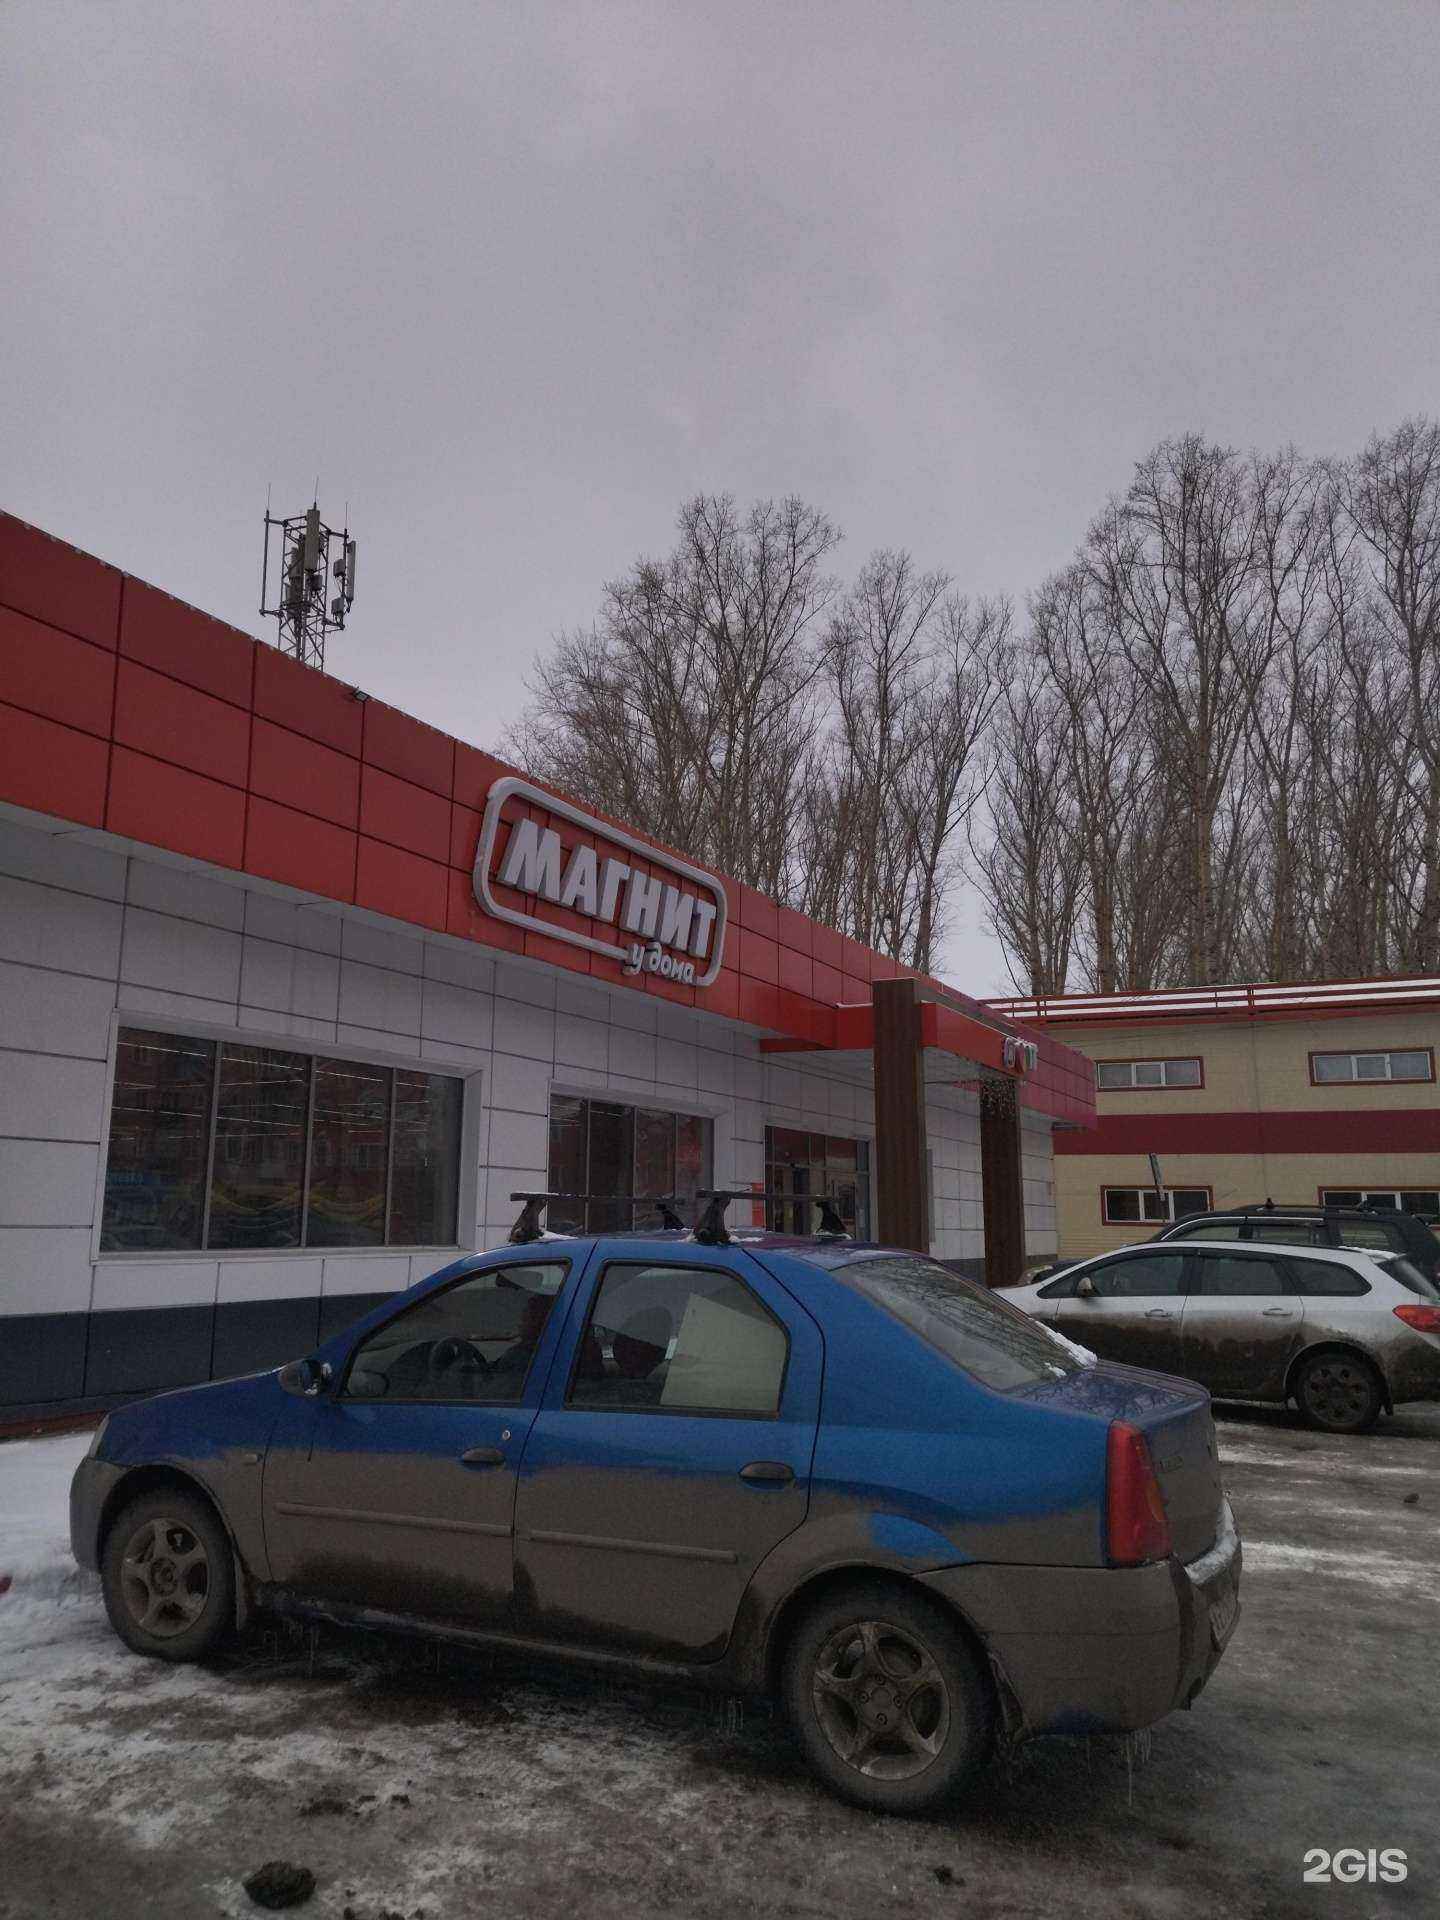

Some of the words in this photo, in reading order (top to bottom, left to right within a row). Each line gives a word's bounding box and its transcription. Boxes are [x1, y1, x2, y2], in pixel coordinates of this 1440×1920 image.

[498, 818, 717, 958] МАГНИТ
[627, 943, 646, 975] у
[644, 941, 695, 984] дома
